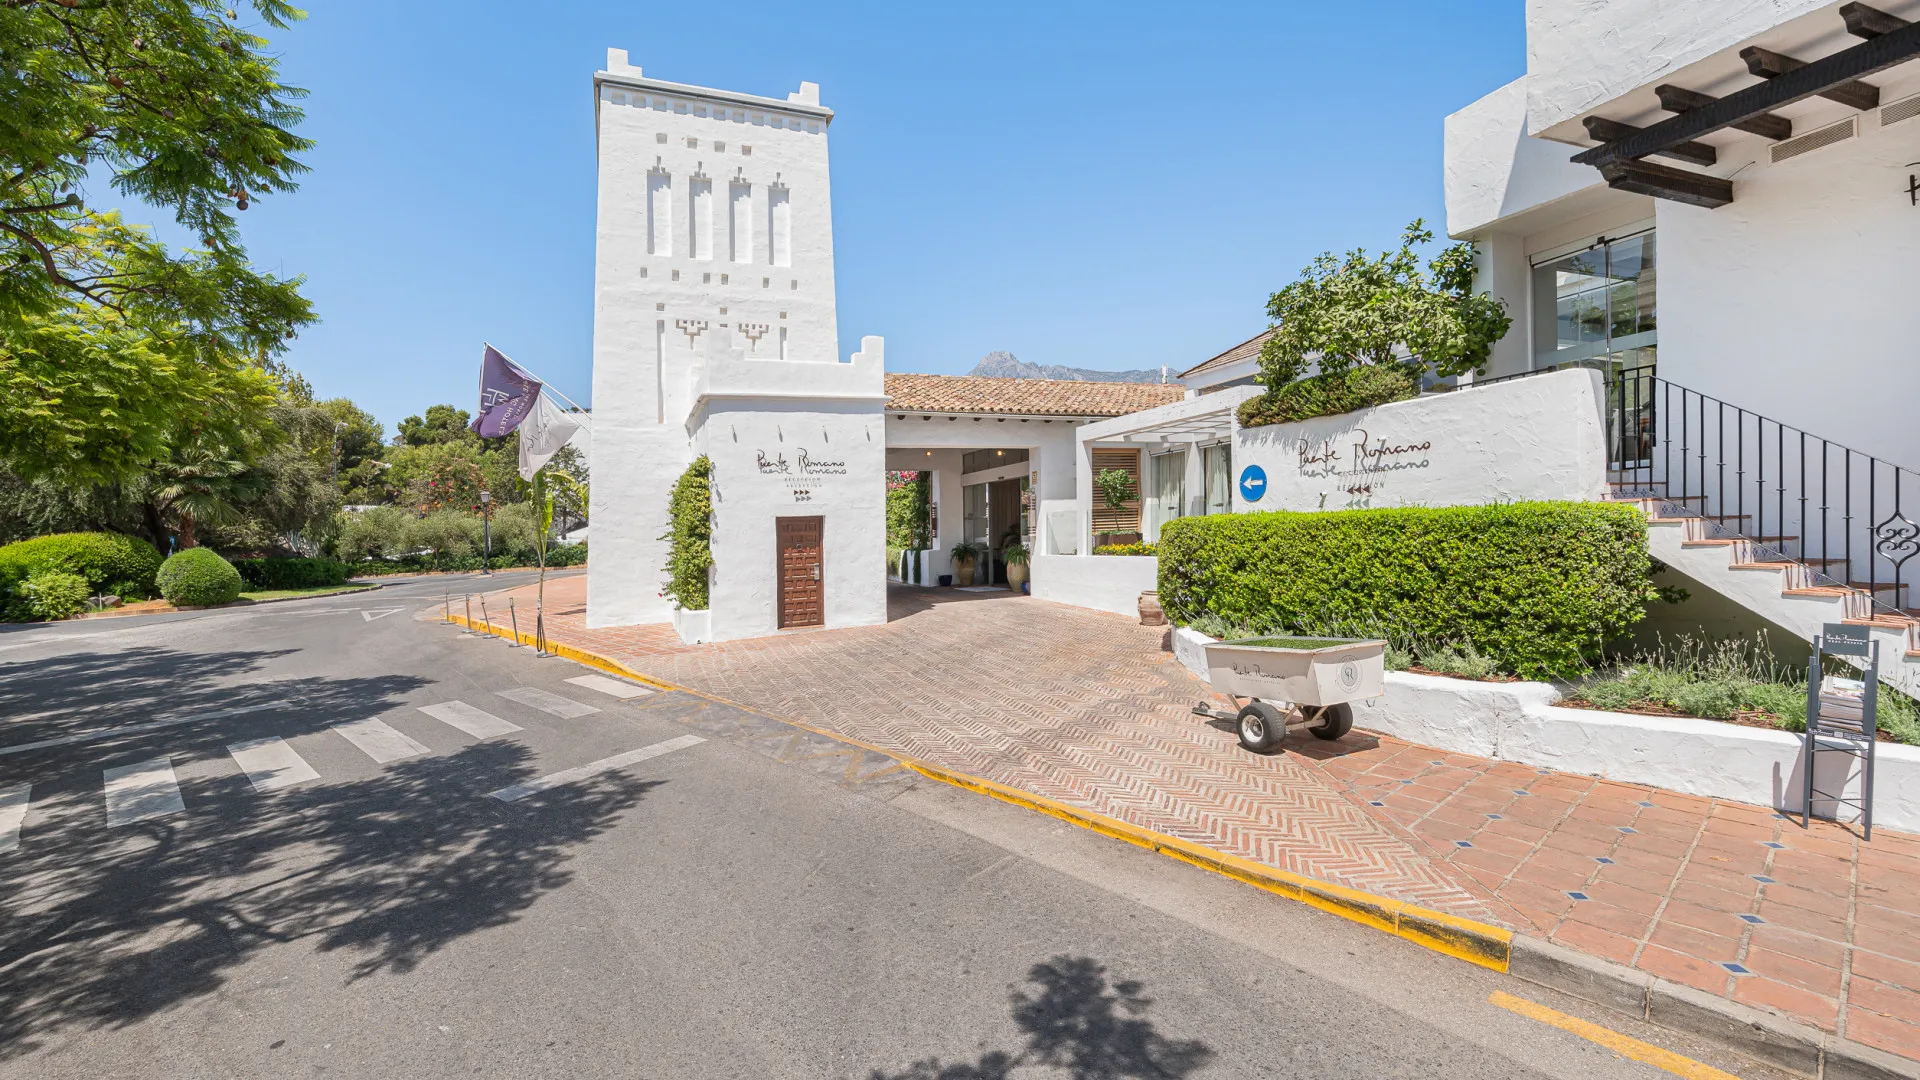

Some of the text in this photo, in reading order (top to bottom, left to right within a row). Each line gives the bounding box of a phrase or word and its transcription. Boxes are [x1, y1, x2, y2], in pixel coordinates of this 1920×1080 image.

[757, 447, 846, 468] Puente Romano
[1298, 428, 1431, 463] Puente Romano
